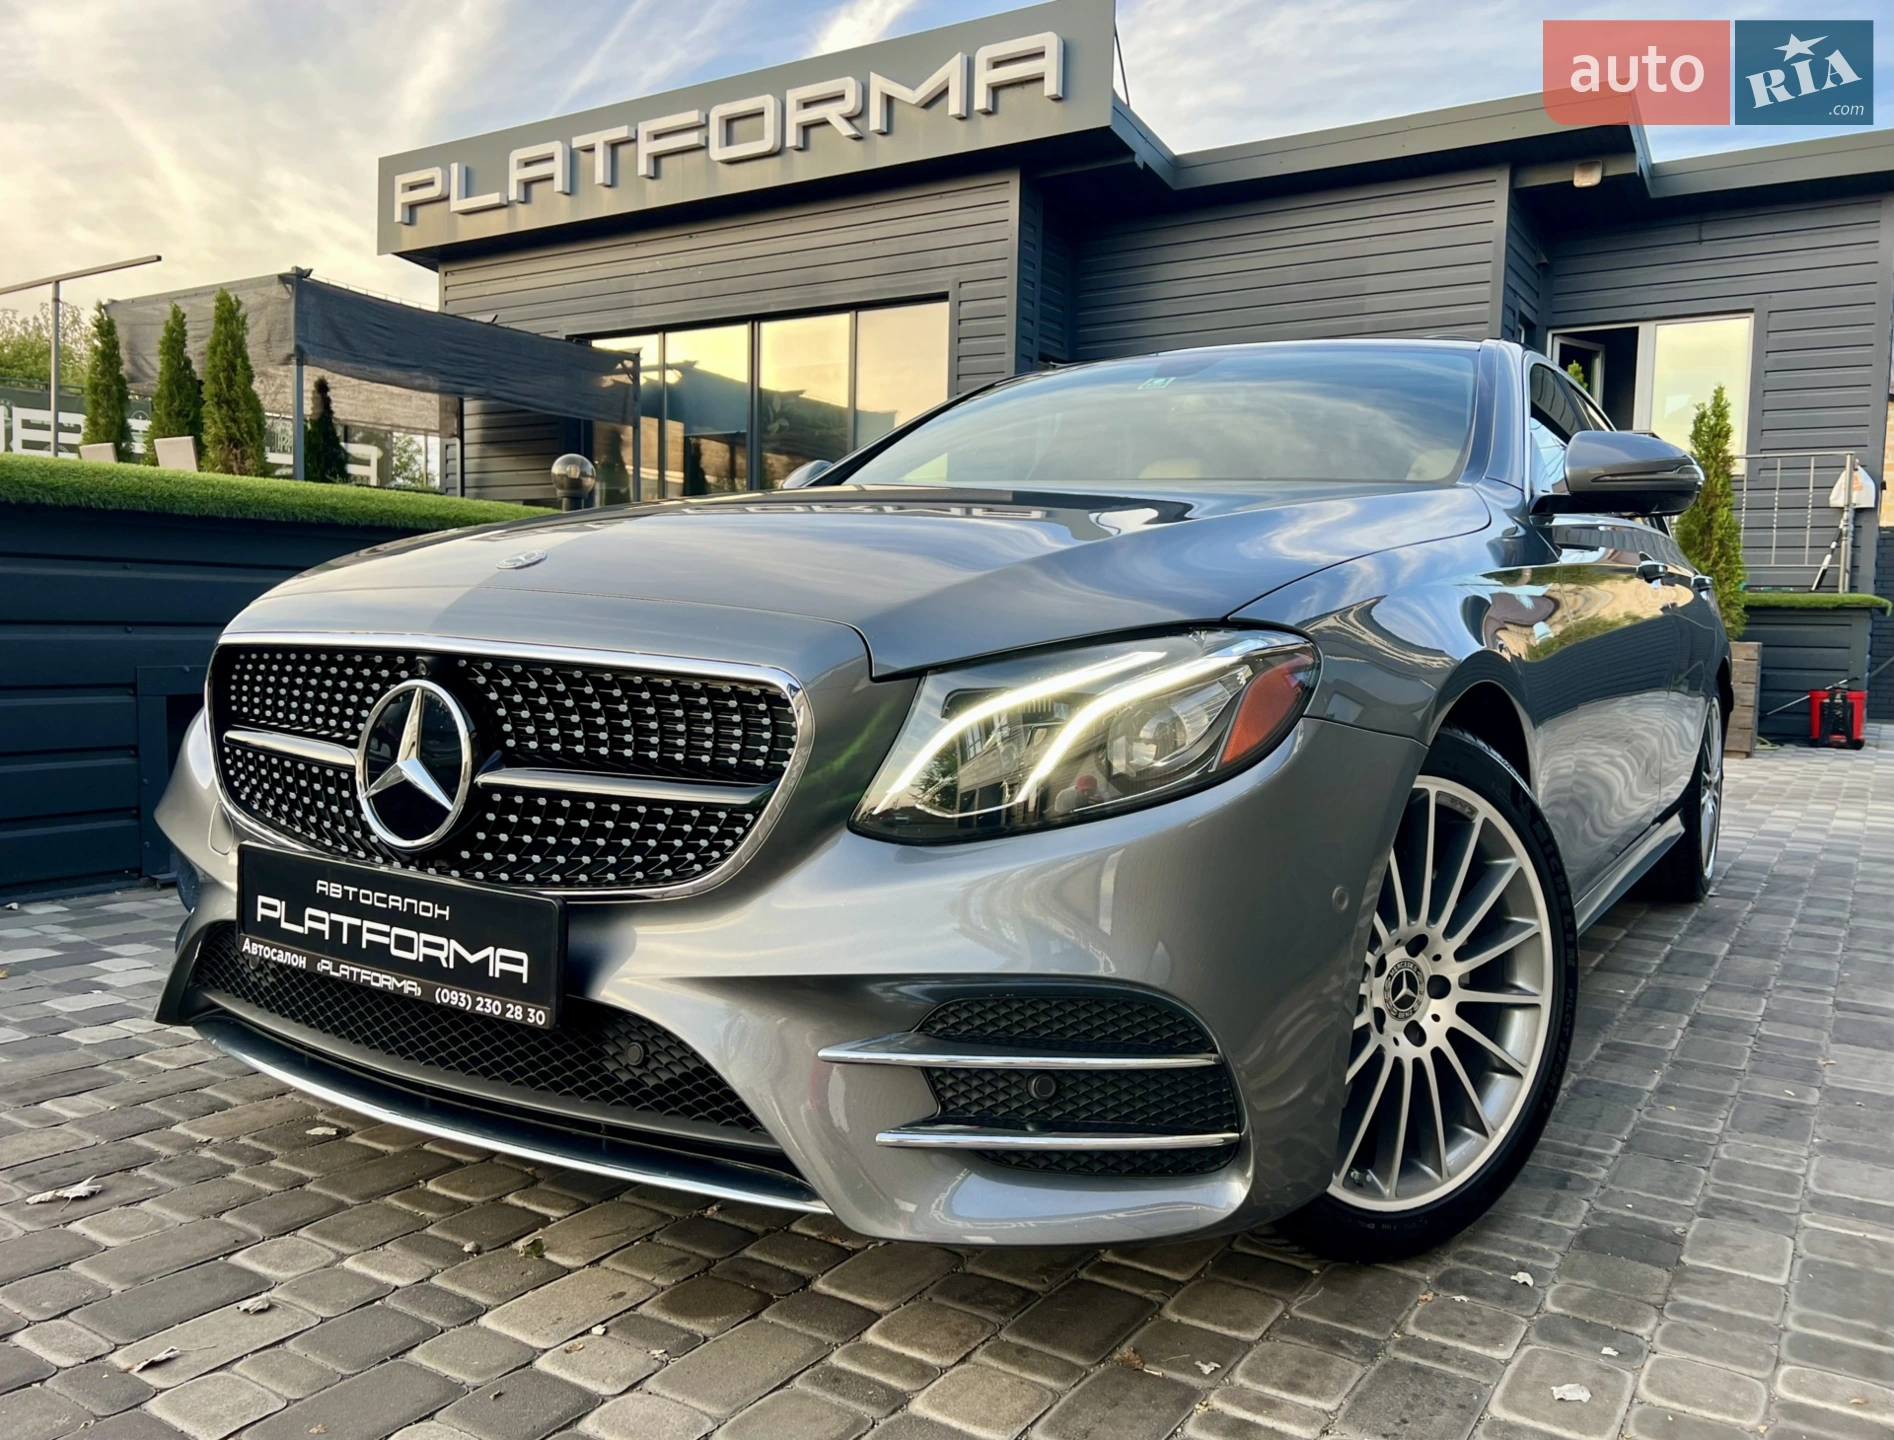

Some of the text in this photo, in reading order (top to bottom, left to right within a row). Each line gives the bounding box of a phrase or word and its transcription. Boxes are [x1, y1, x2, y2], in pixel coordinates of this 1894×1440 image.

[393, 31, 1065, 225] PLATFORMA
[256, 894, 529, 984] PLATFORMA
[316, 879, 450, 921] АВТОСАЛОН
[241, 937, 307, 970] Автосалон
[435, 987, 472, 1011] (093)
[475, 996, 502, 1016] 230
[505, 1003, 523, 1021] 28
[527, 1007, 546, 1026] 30
